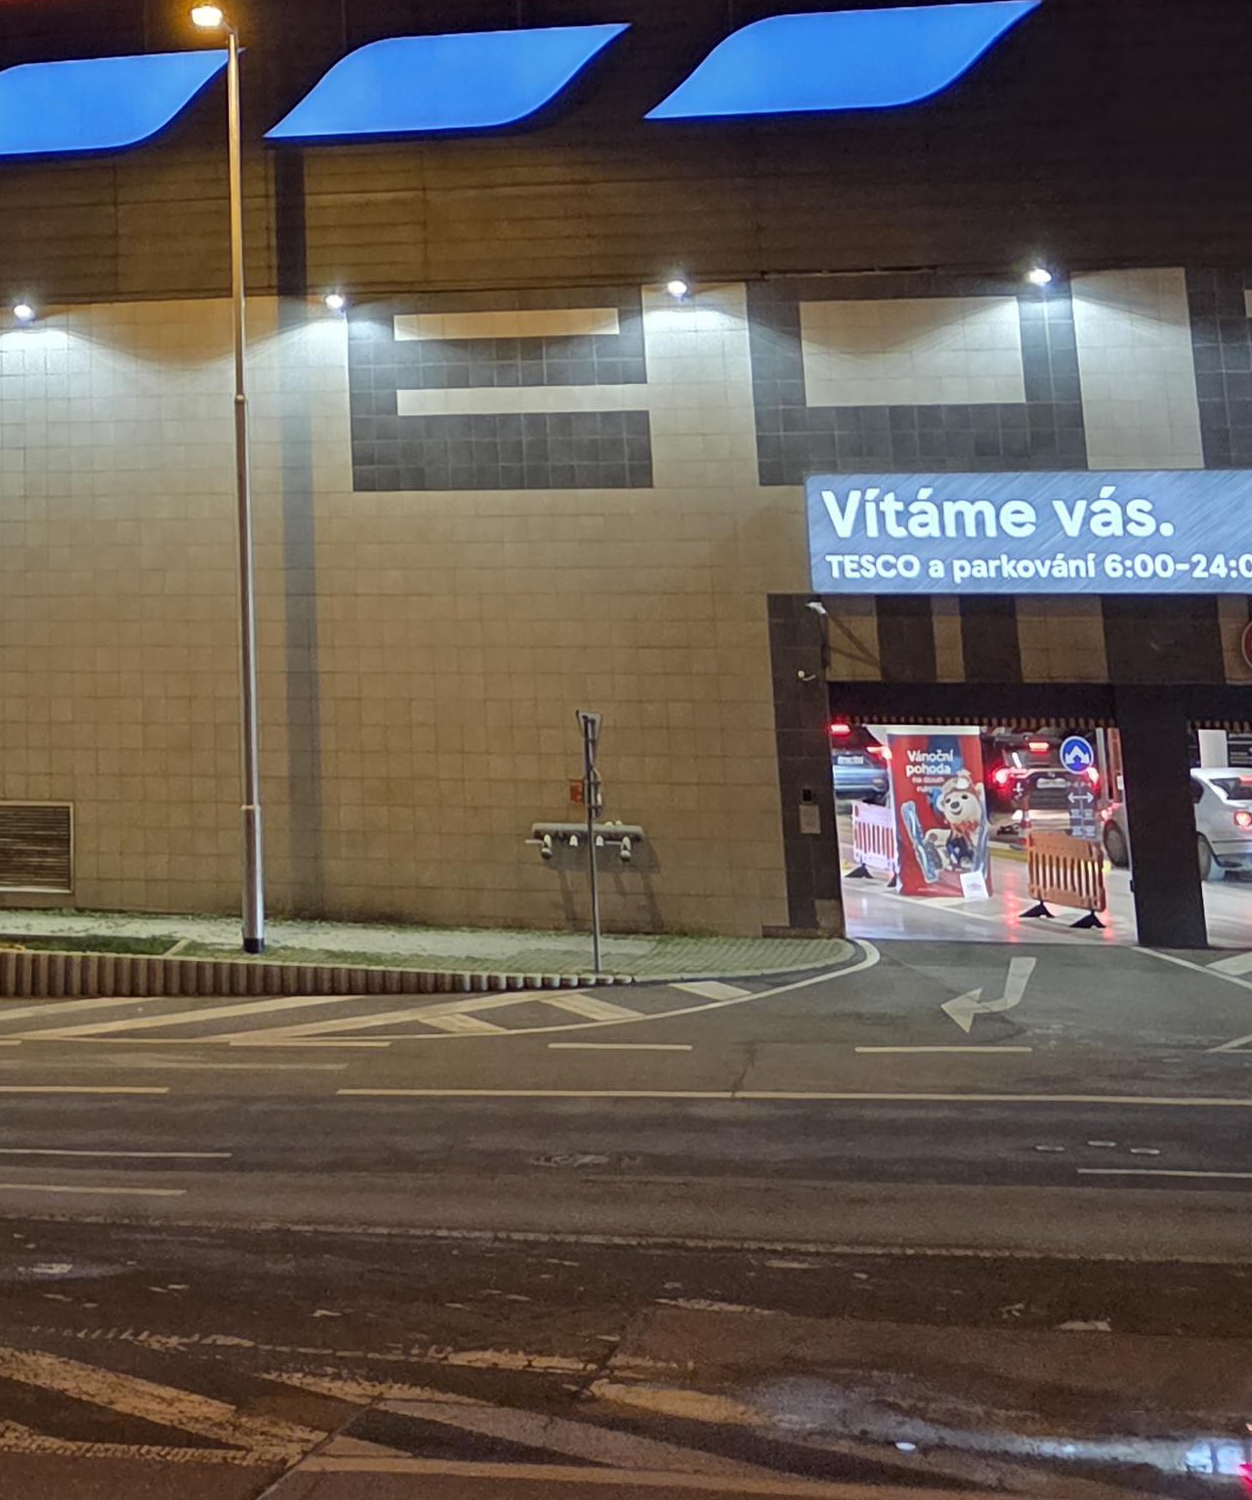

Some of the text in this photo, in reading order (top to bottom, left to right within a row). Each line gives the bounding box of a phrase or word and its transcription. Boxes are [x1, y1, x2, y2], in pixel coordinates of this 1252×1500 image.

[821, 486, 1175, 538] Vítáme vás.
[825, 554, 920, 578] TESCO
[928, 560, 945, 578] a
[953, 553, 1096, 584] parkování
[907, 749, 953, 762] Vánoční
[906, 763, 951, 777] pohoda
